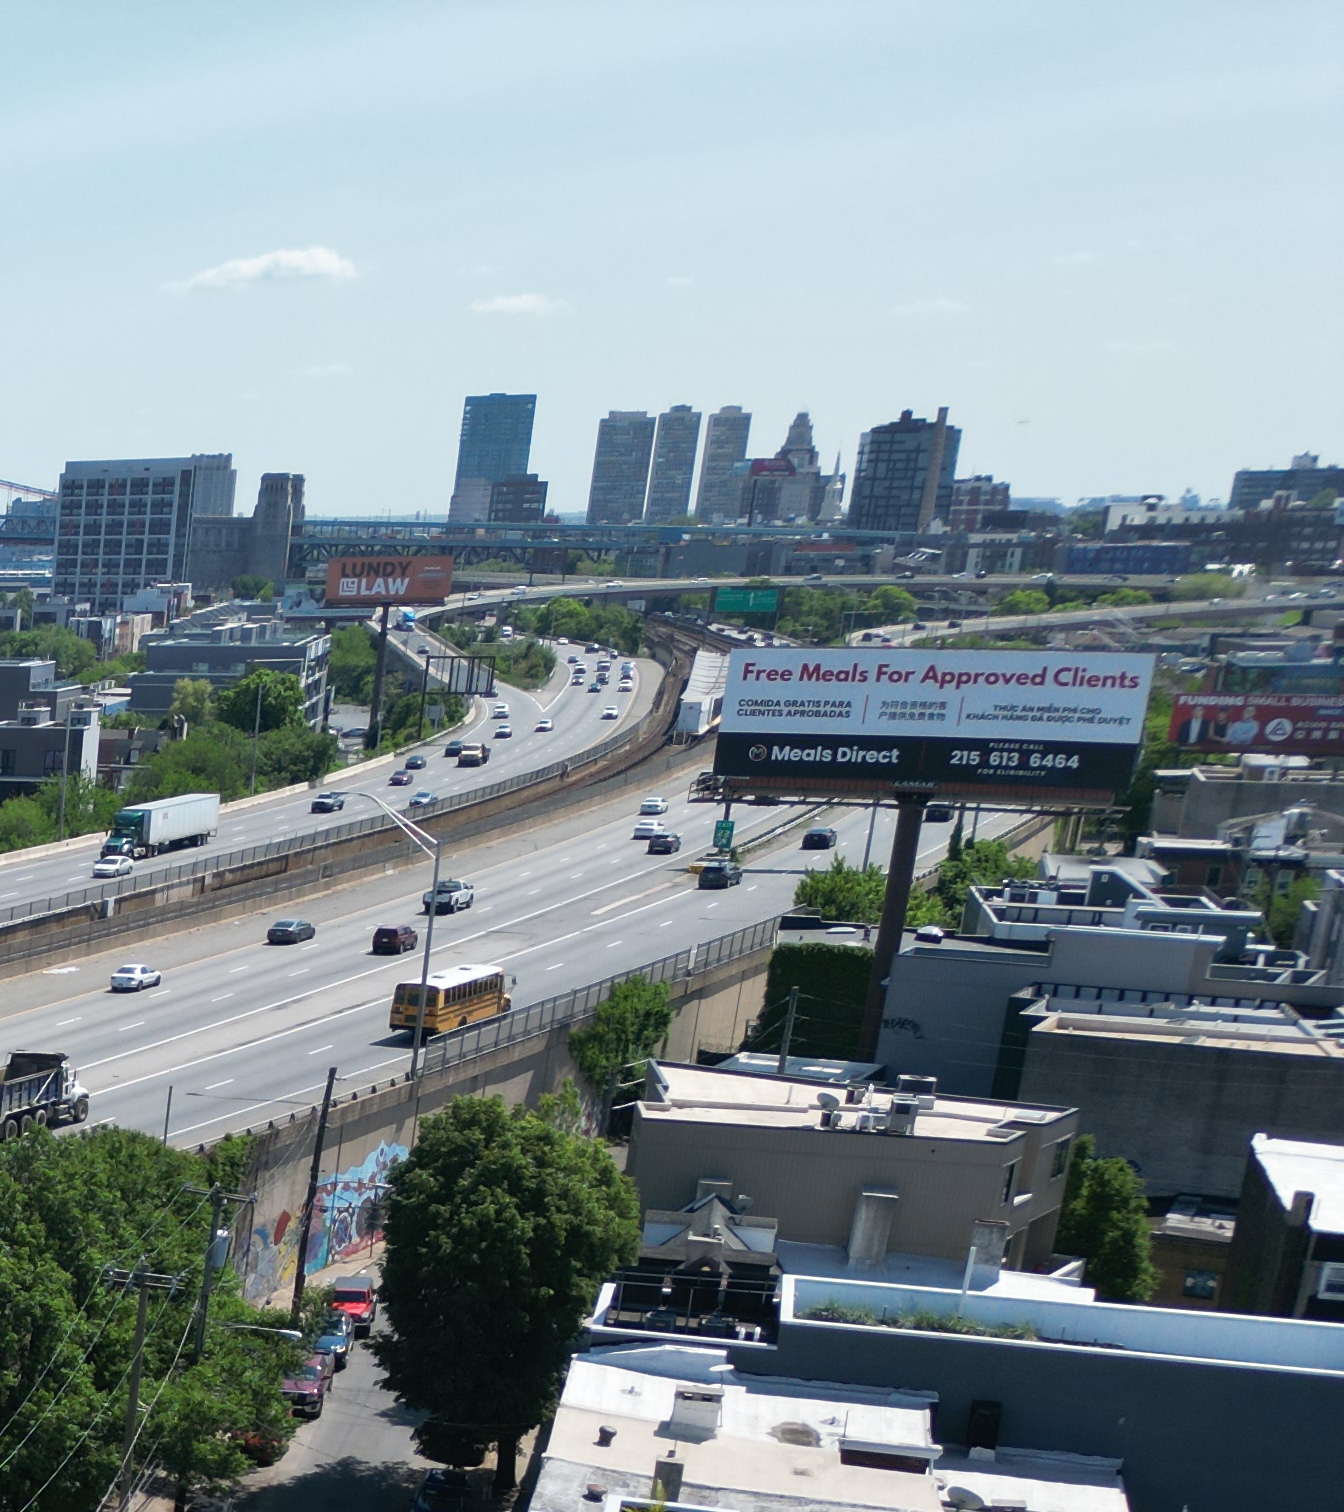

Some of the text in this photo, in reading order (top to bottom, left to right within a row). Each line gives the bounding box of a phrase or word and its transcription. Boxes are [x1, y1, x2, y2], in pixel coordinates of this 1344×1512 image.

[340, 561, 412, 578] LUNDY
[359, 577, 410, 595] LAW
[742, 662, 1141, 690] Free Meals For Approved Clients
[783, 699, 822, 708] GRATIS
[822, 699, 852, 709] PARA
[736, 708, 852, 719] CLIENTES APROBADAS
[771, 745, 834, 763] Meals
[836, 746, 900, 764] Direct
[949, 750, 1080, 769] 215 613 6464
